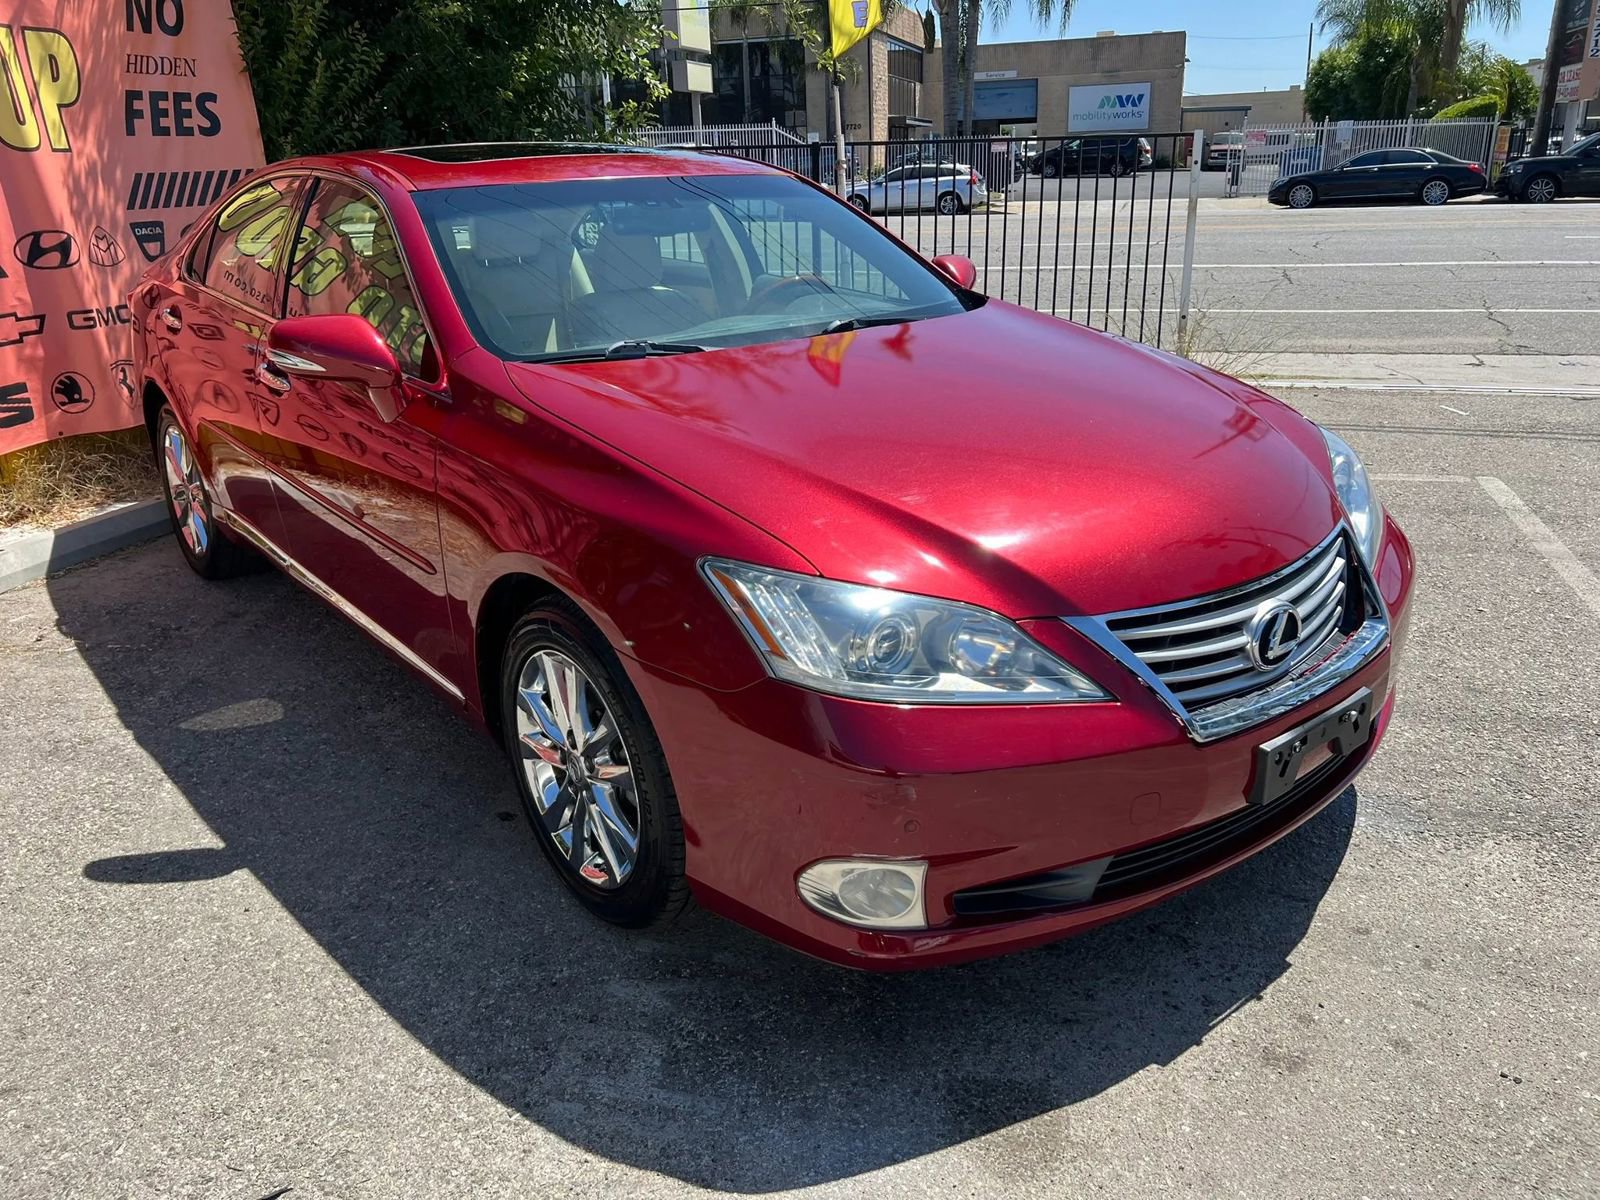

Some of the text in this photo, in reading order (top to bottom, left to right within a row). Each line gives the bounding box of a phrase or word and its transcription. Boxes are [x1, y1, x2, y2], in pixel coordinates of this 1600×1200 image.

[126, 0, 184, 36] NO
[852, 0, 869, 28] E
[125, 53, 197, 77] HIDDEN
[125, 89, 222, 137] FEES
[1073, 109, 1143, 121] mobilityworks
[134, 226, 163, 236] DACIA
[66, 304, 132, 331] GMC
